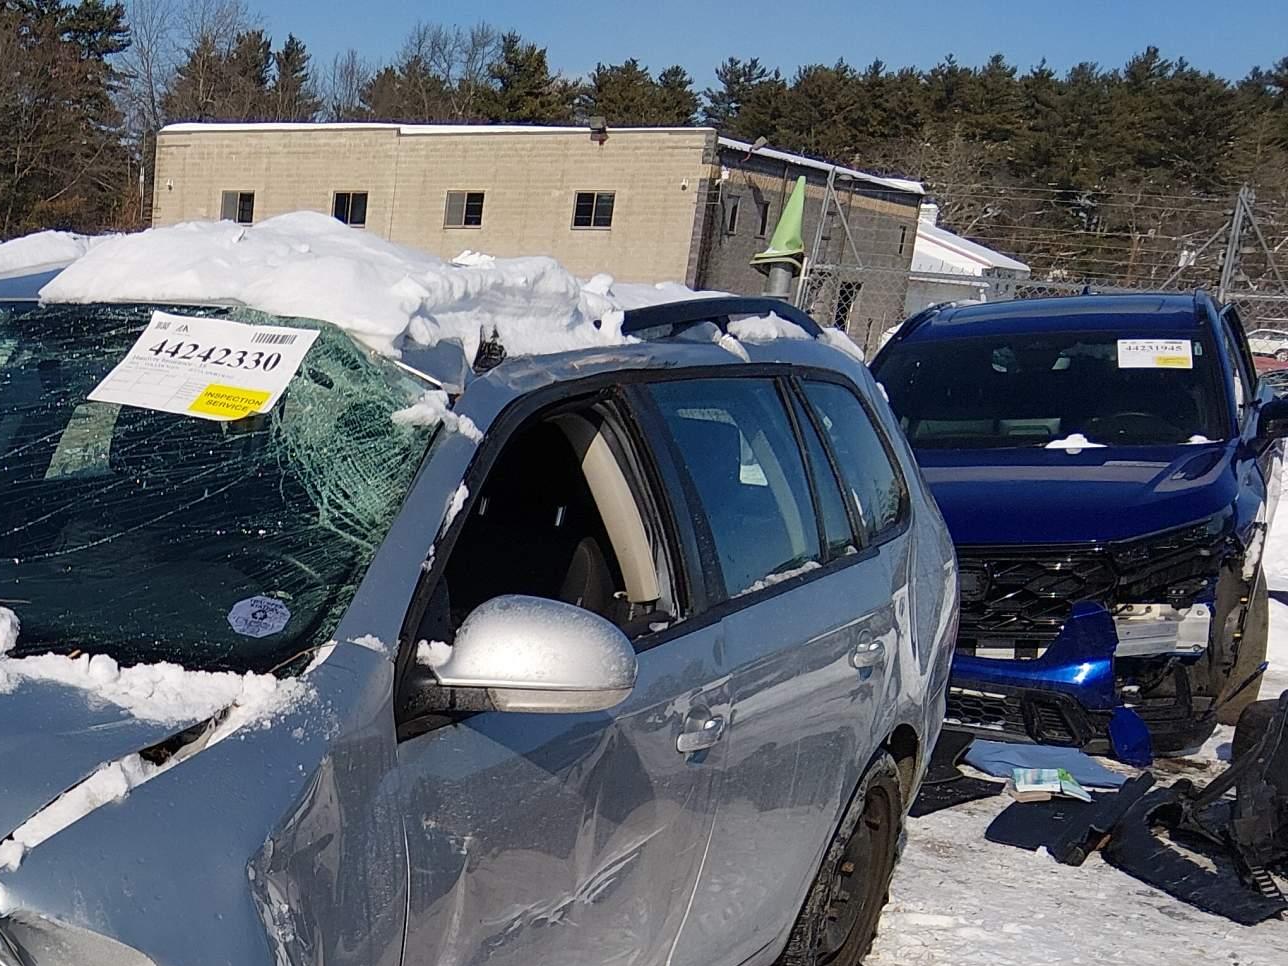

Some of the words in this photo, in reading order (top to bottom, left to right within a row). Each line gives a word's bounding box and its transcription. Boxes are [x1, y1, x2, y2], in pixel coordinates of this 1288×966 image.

[149, 339, 282, 372] 44242330
[204, 391, 263, 406] INSPECTION
[206, 400, 250, 412] SERVICE
